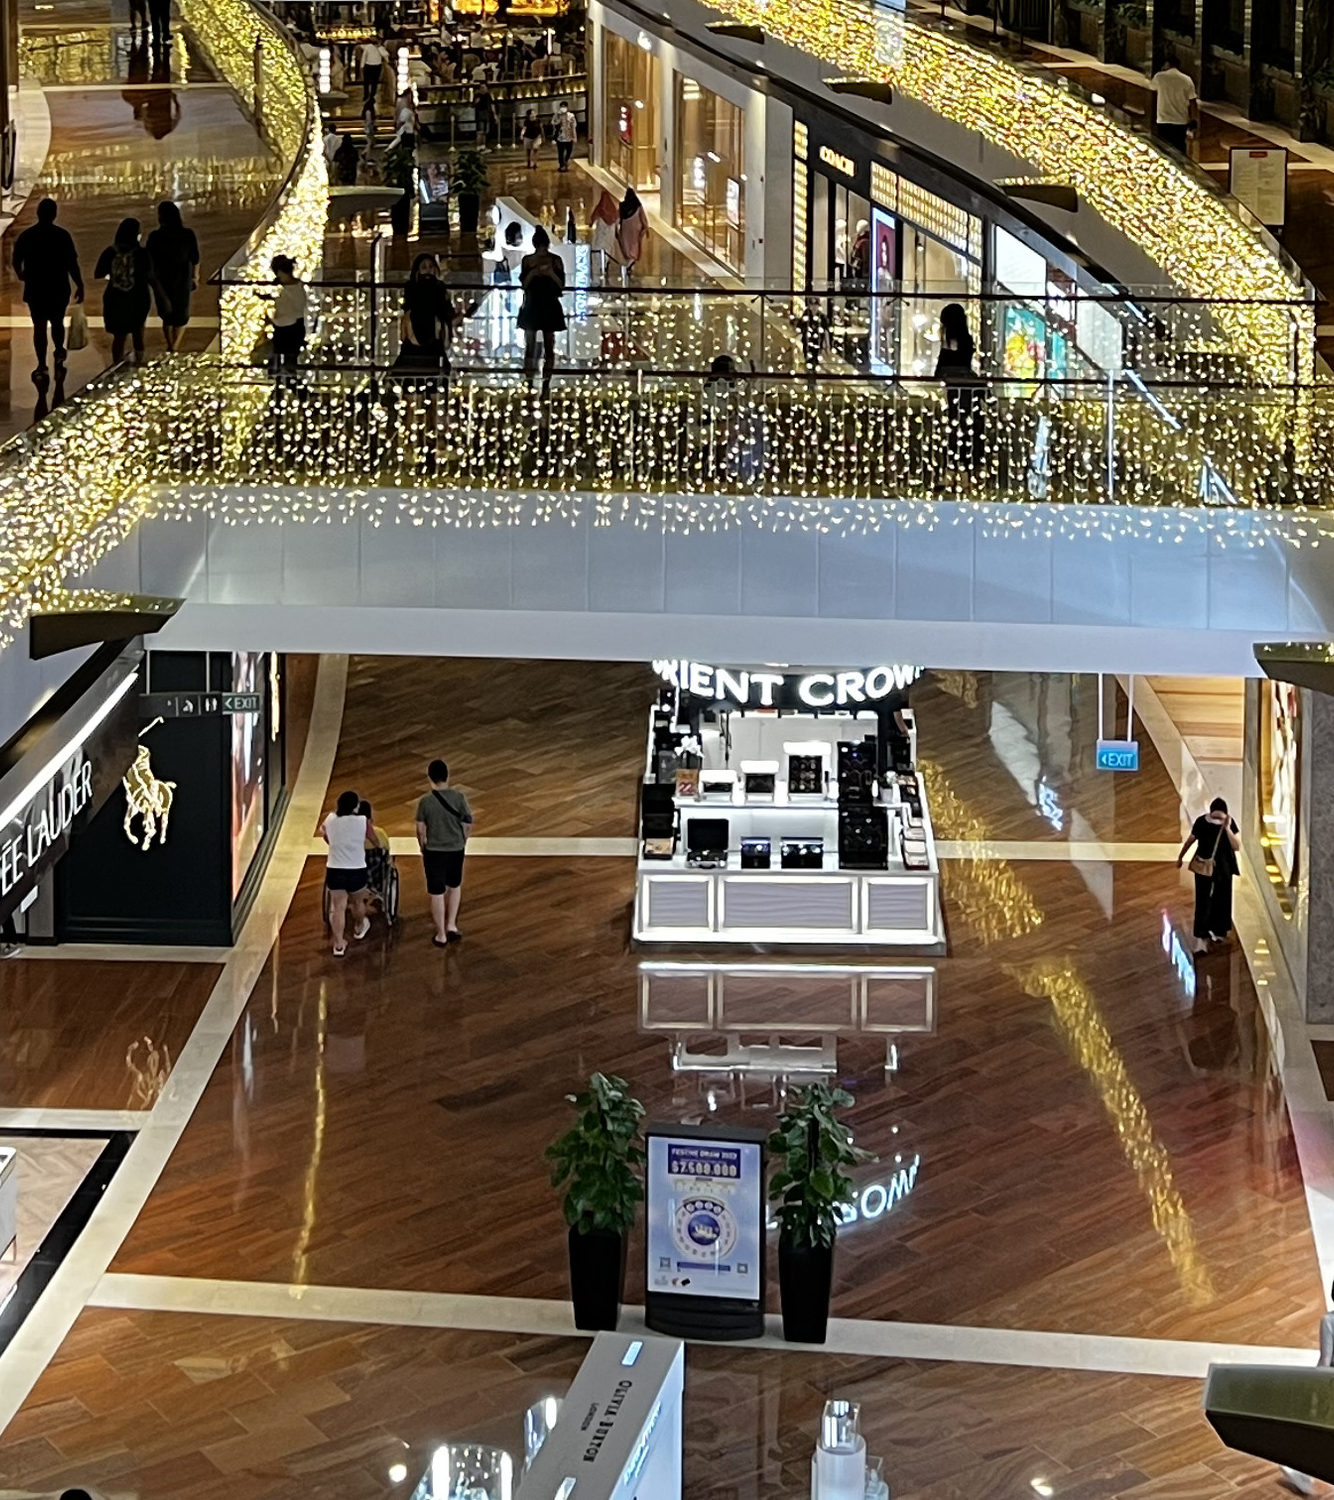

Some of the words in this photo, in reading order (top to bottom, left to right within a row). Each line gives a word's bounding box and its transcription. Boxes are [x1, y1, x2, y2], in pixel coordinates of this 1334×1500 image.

[234, 697, 257, 710] EXIT
[1108, 752, 1133, 767] EXIT
[27, 760, 93, 868] LAUDER
